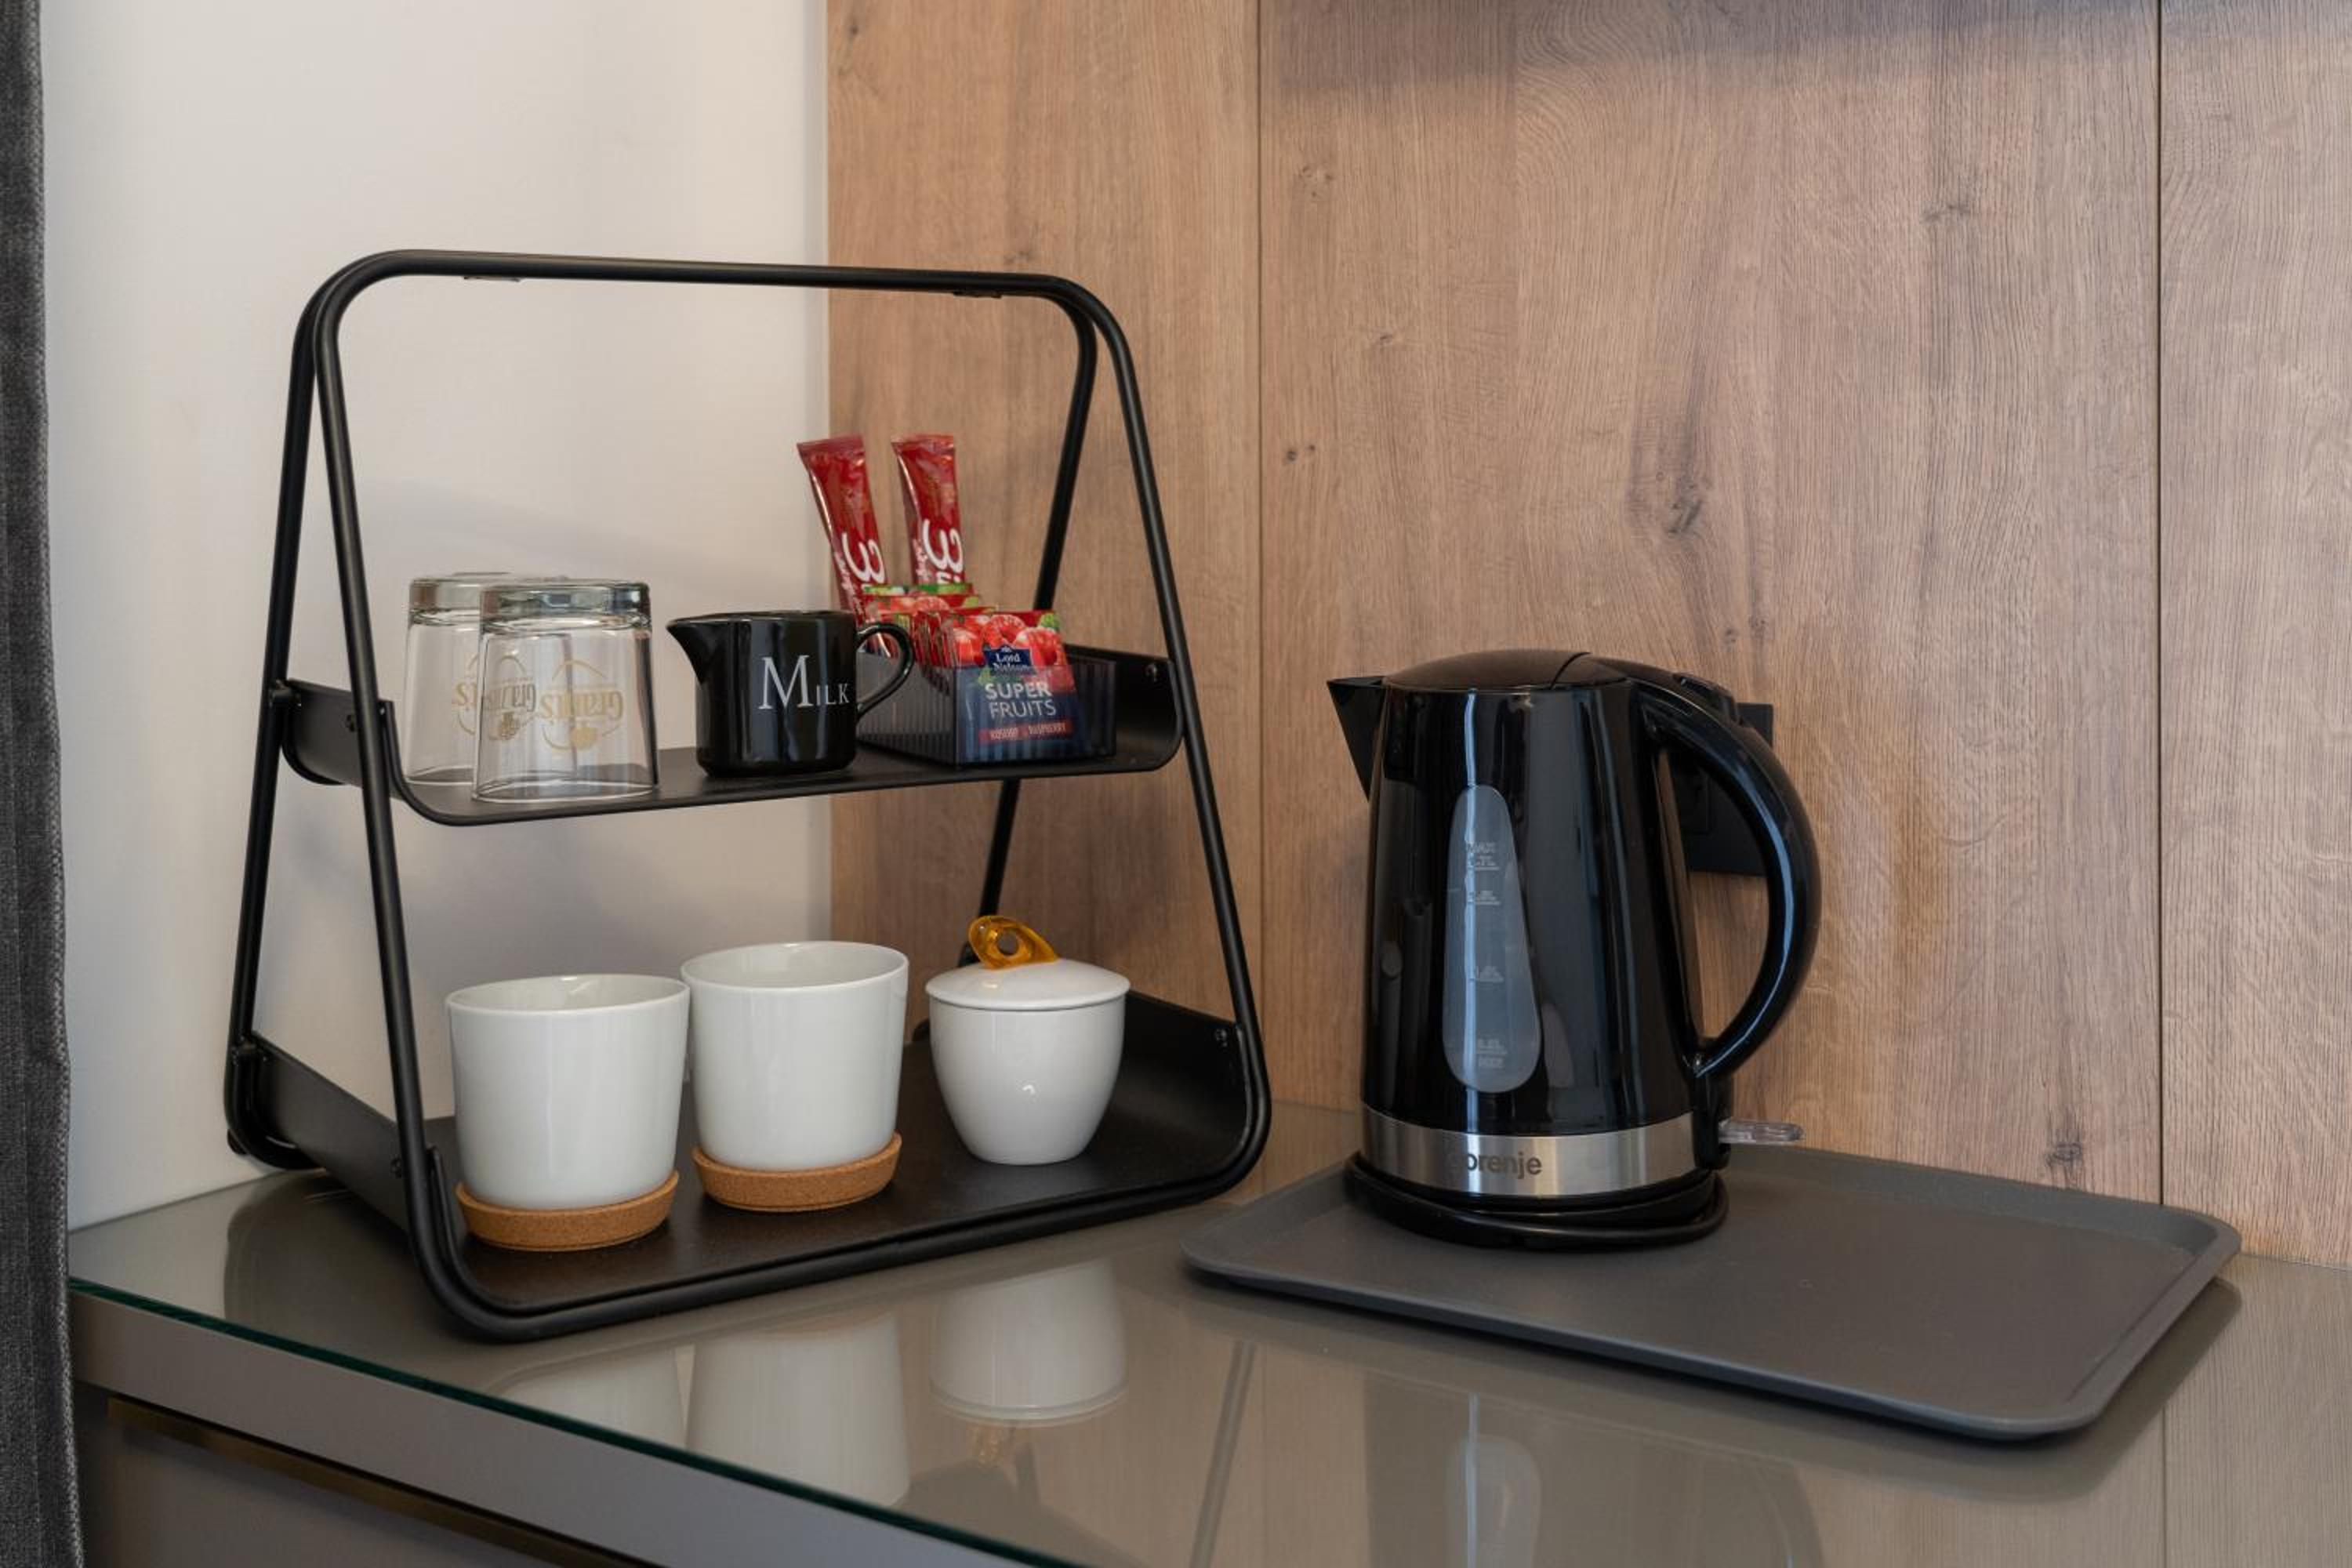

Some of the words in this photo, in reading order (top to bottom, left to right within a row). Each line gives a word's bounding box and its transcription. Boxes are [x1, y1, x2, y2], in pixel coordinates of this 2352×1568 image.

[985, 682, 1053, 700] SUPER
[989, 699, 1057, 719] FRUITS
[1465, 1152, 1543, 1179] orenje
